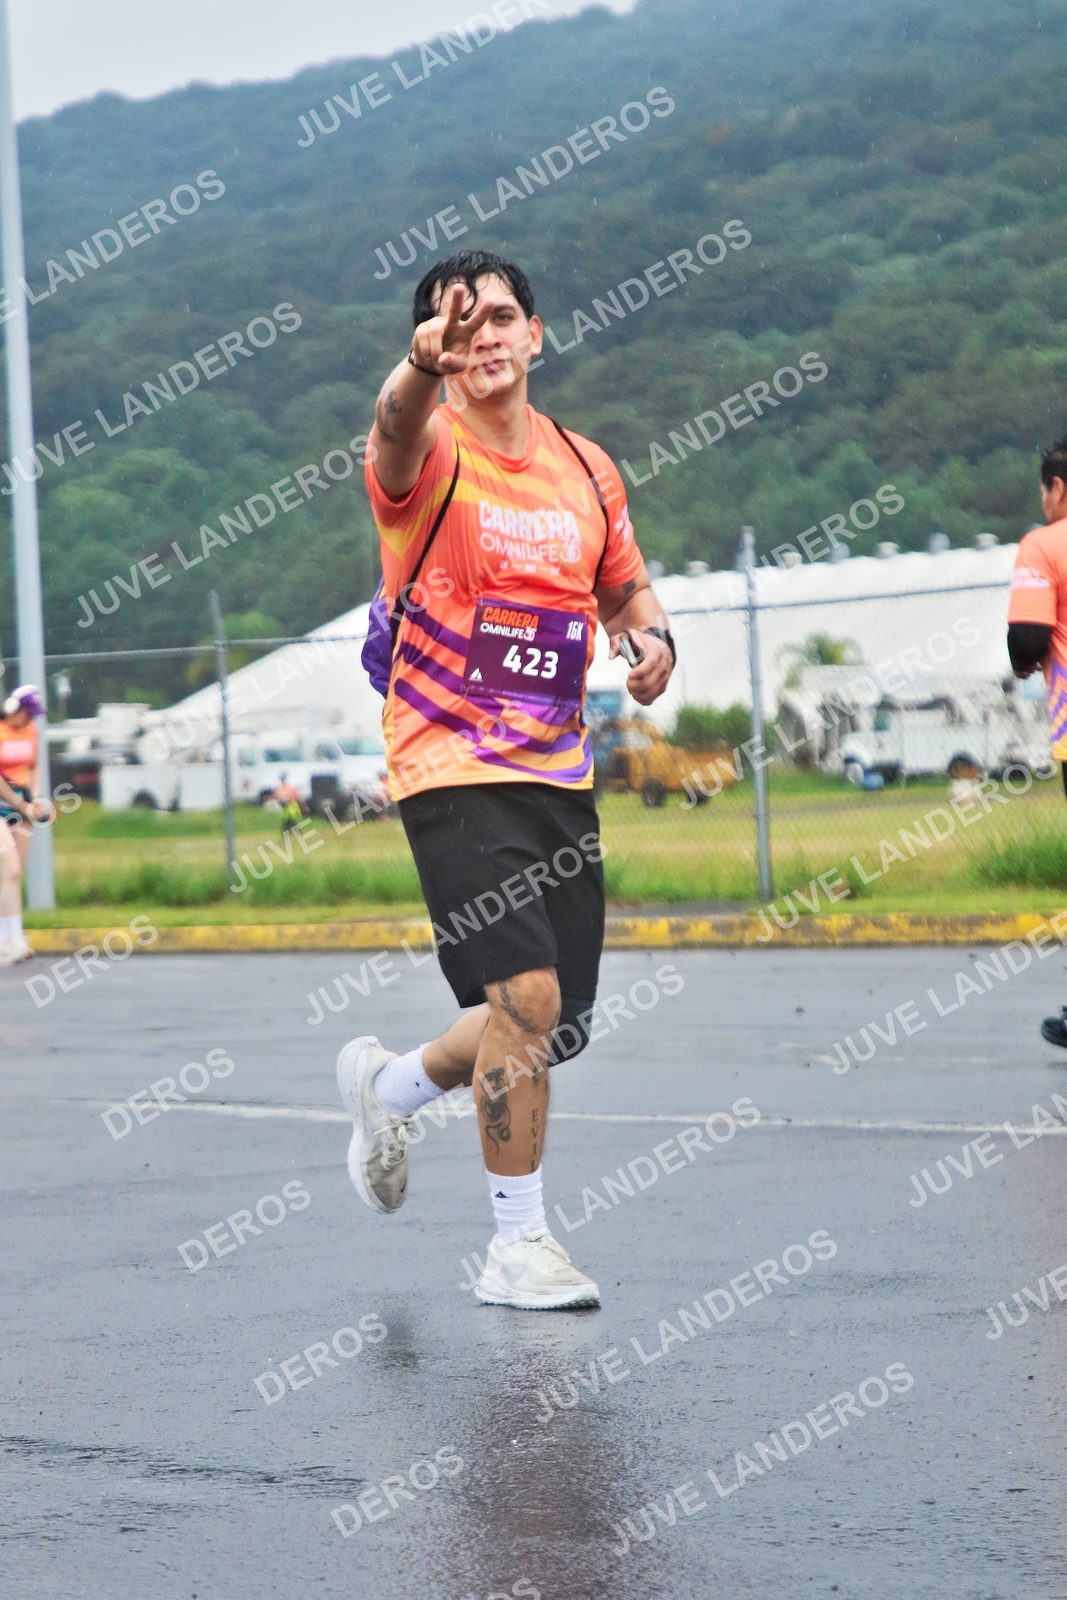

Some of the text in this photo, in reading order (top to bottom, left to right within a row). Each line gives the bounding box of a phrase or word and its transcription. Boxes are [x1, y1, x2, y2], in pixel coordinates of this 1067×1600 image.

[479, 499, 580, 541] CARRERA
[480, 532, 557, 563] OMNILIFE
[480, 622, 525, 640] OMNILIFE
[482, 606, 540, 628] CARRERA
[502, 644, 559, 680] 423
